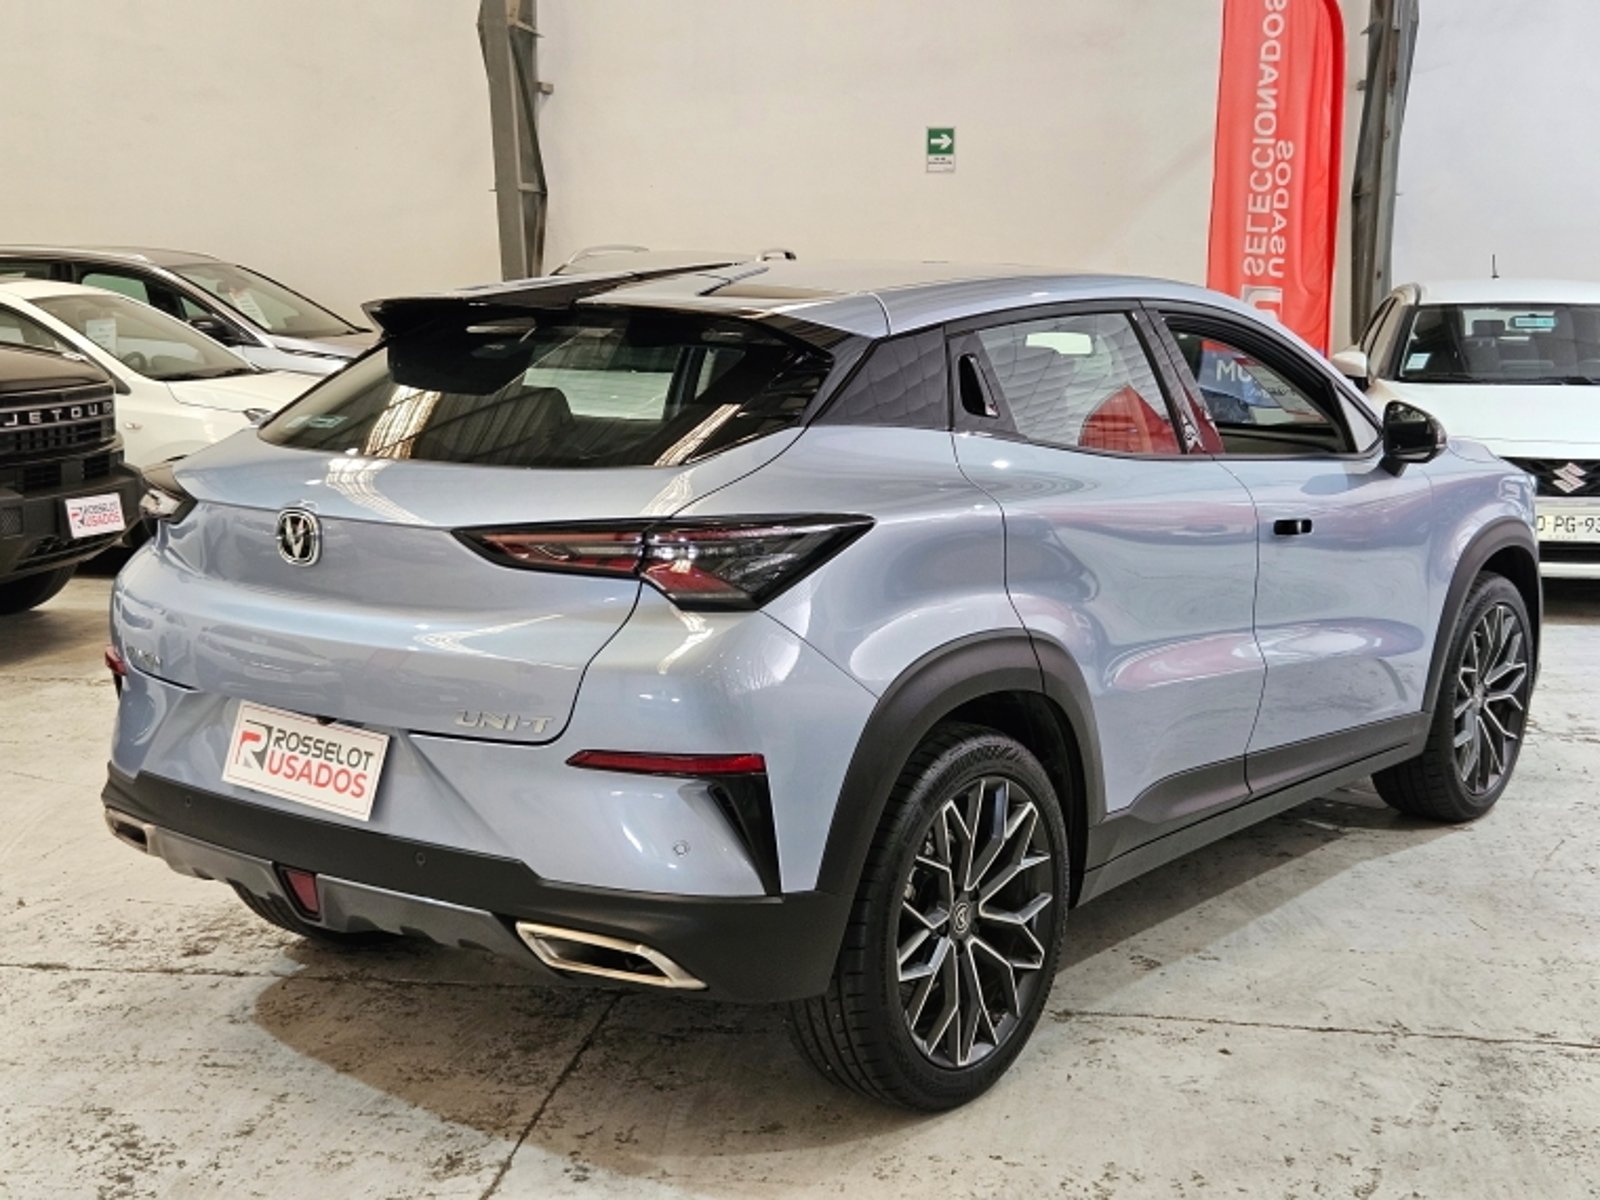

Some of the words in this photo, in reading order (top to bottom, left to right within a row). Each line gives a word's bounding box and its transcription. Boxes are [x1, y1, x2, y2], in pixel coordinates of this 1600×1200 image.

[4, 401, 113, 427] JETOUR
[456, 710, 554, 734] UNI-T
[273, 727, 375, 772] ROSSELOT
[267, 751, 368, 799] USADOS
